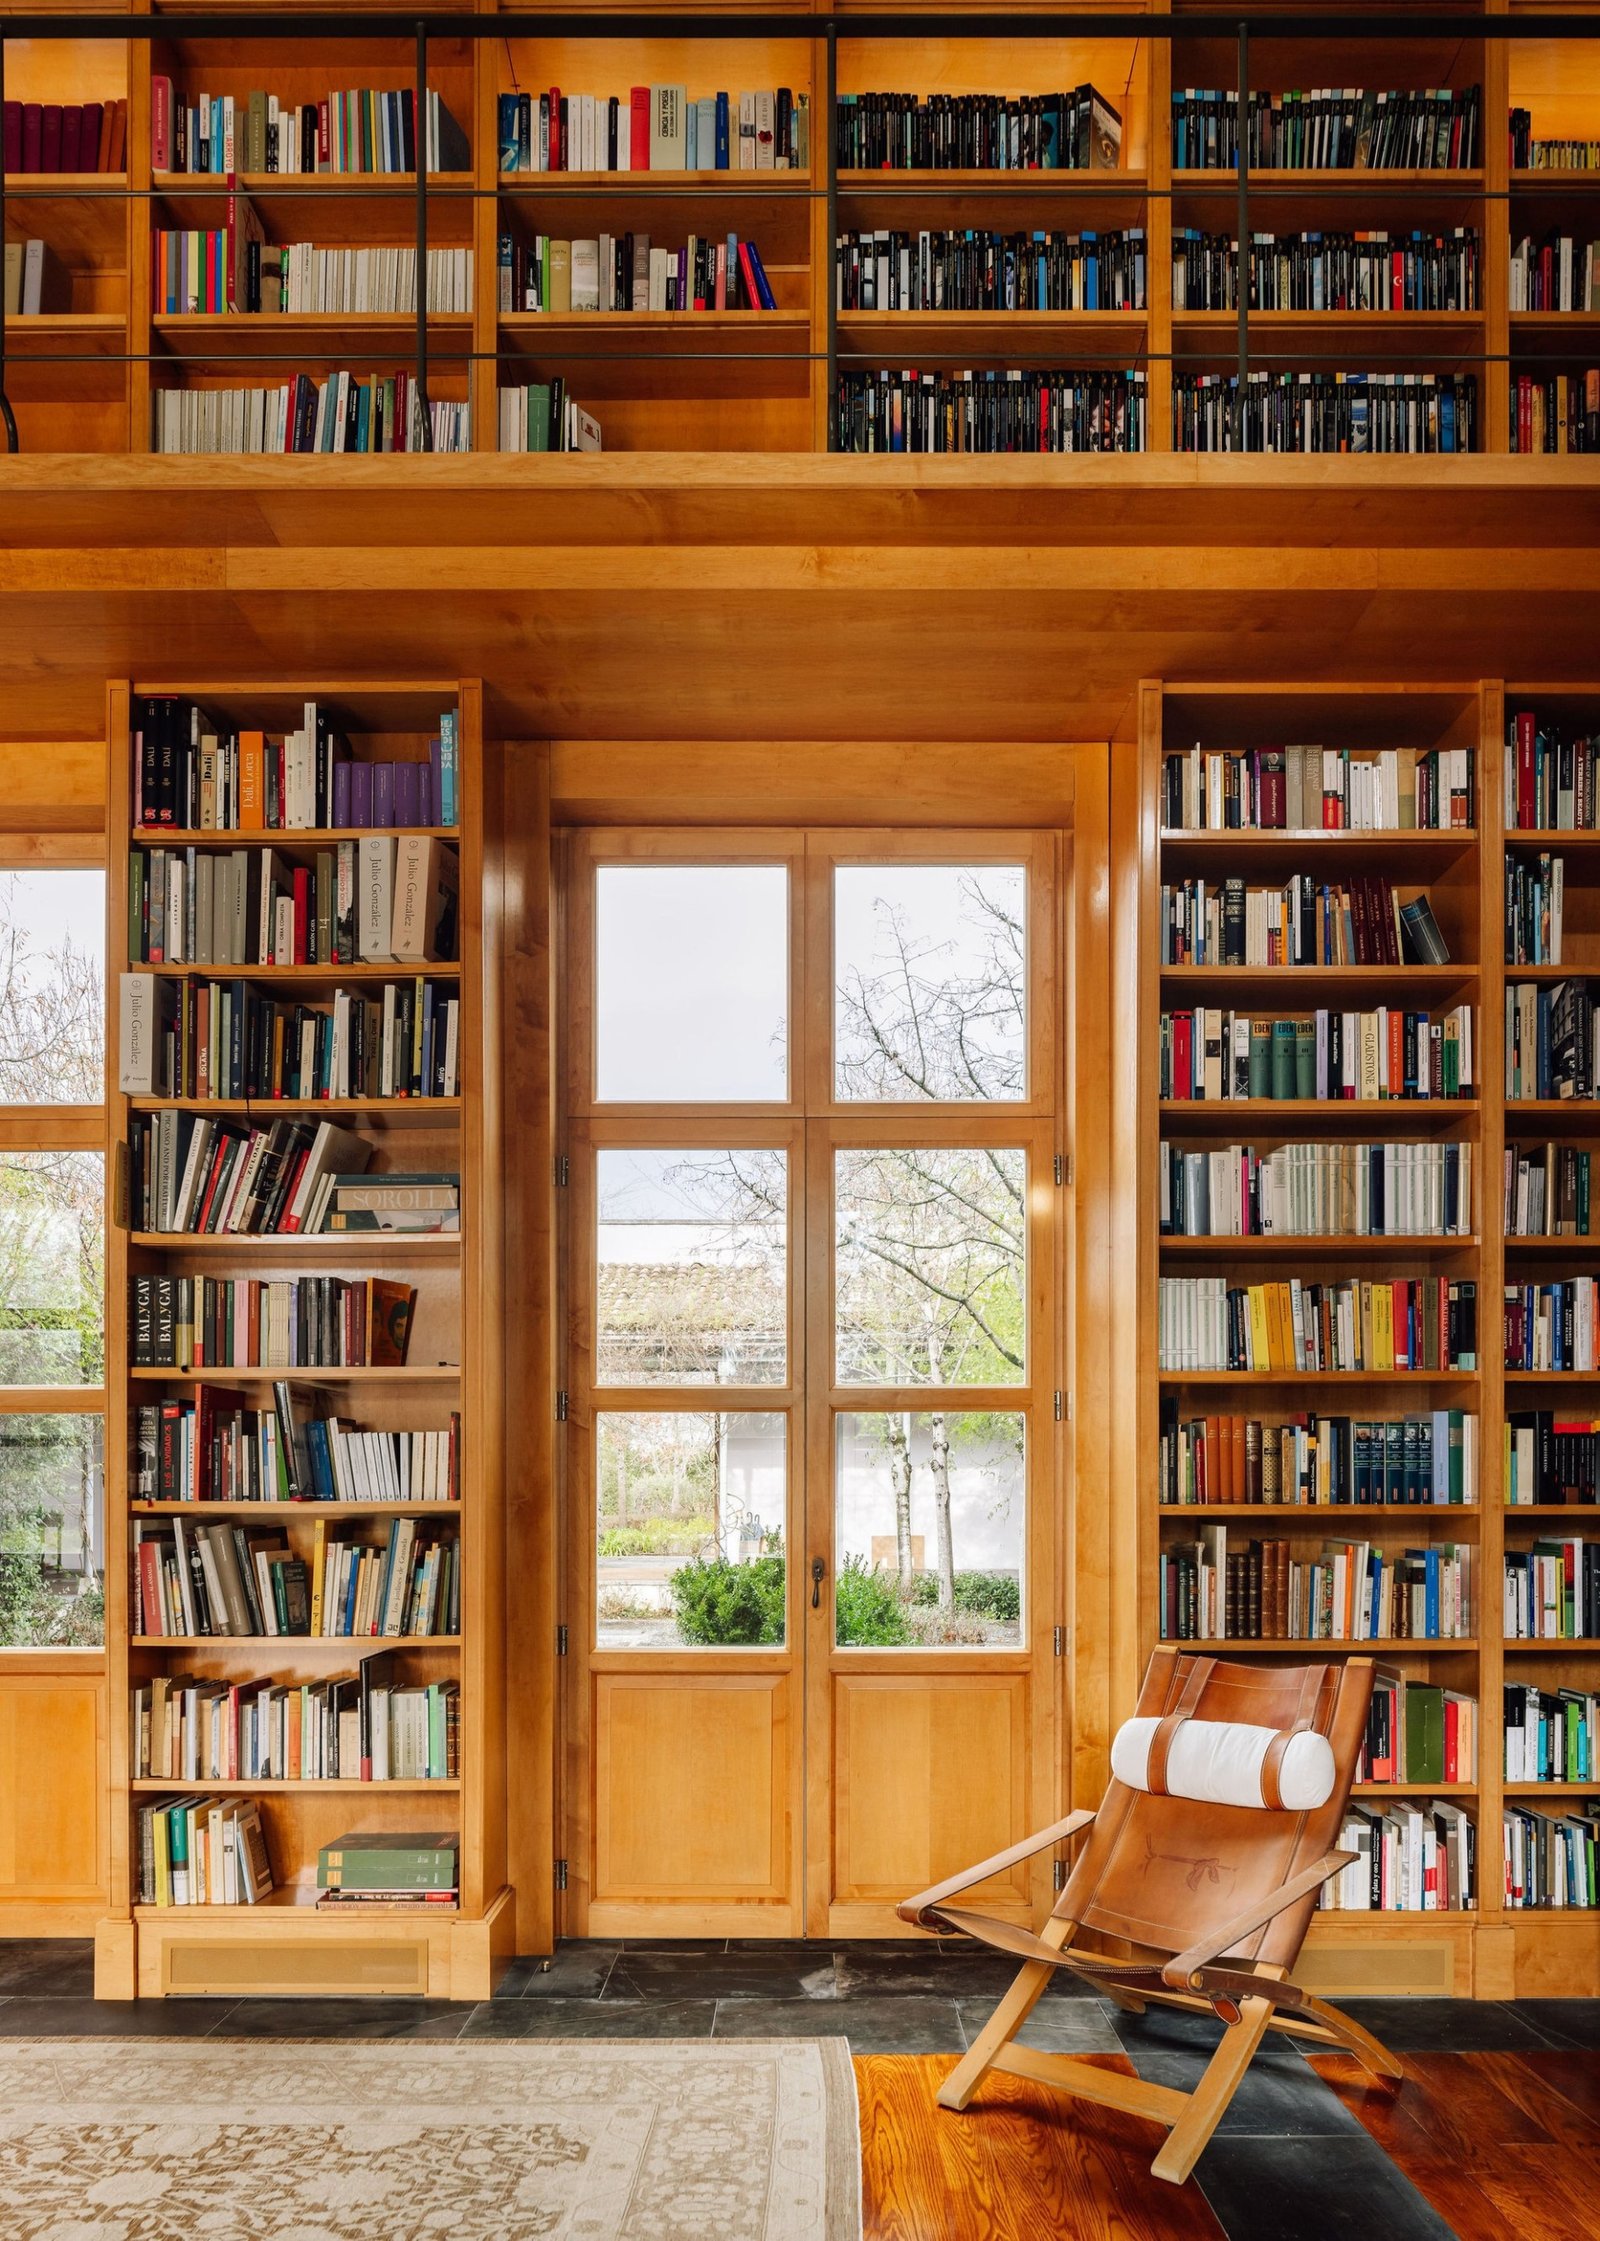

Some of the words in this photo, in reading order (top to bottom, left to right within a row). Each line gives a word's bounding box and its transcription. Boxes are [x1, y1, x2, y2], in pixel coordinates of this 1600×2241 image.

[660, 89, 669, 109] POESÍA
[661, 116, 669, 137] CIENCIA
[225, 137, 233, 169] ARROYO
[146, 746, 155, 767] DALÍ
[162, 747, 171, 767] DALÍ
[242, 752, 254, 782] Lorca
[203, 757, 212, 779] Dalí
[370, 857, 382, 880] Julio
[407, 856, 419, 879] Julio
[371, 883, 382, 927] González
[405, 882, 418, 926] González
[130, 993, 142, 1017] Julio
[1254, 1024, 1270, 1033] EDEN
[1278, 1024, 1294, 1033] EDEN
[1297, 1024, 1313, 1033] EDEN
[131, 1020, 142, 1064] González
[1365, 1033, 1375, 1084] GLADSTONE
[436, 1067, 445, 1083] Miró
[247, 1136, 264, 1175] ZULOAGA
[353, 1190, 456, 1209] SOROLLA
[399, 1537, 408, 1564] Granada
[398, 1566, 403, 1574] de
[393, 1577, 402, 1601] jardines
[1372, 1878, 1380, 1893] plata
[1372, 1894, 1378, 1902] de
